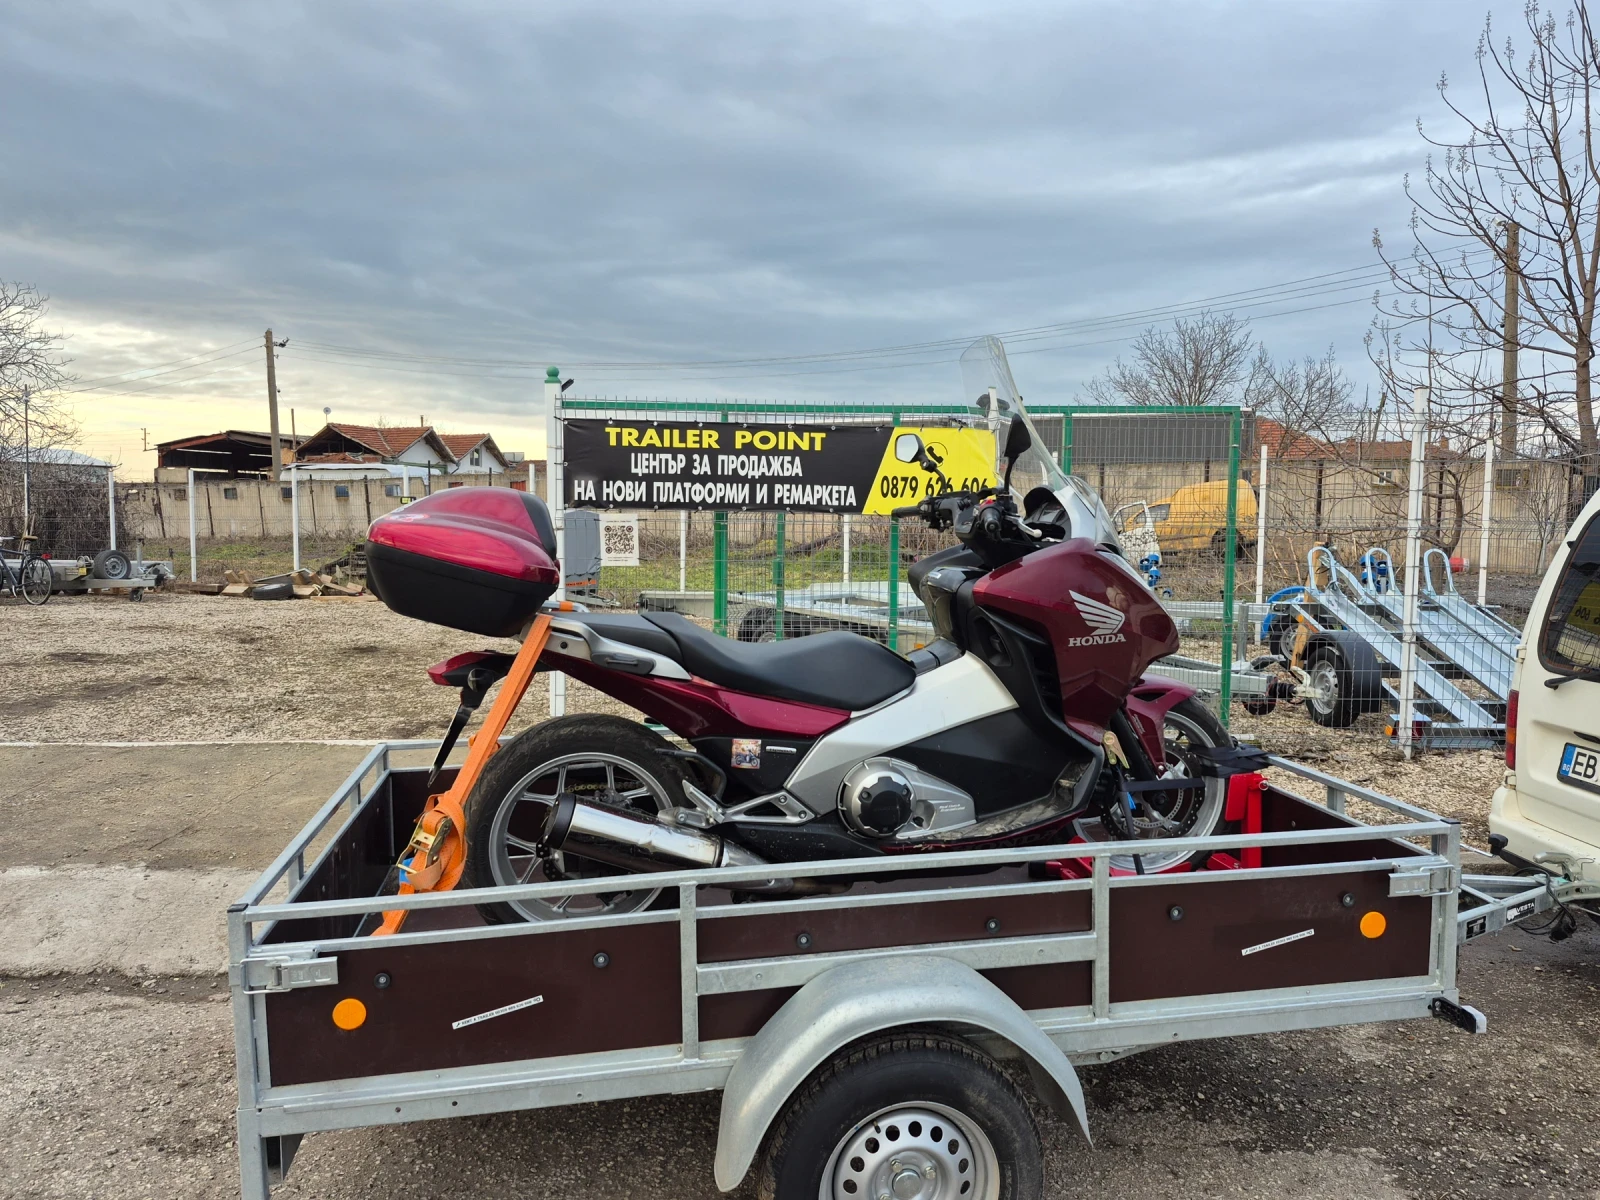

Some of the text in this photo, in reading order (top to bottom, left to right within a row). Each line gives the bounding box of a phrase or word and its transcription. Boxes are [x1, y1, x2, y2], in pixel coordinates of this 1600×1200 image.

[605, 427, 827, 451] TRAILER POINT
[631, 453, 803, 479] ЦЕНТЪР ЗА ПРОДАЖБА
[574, 480, 857, 506] НА НОВИ ПЛАТФОРМИ И РЕМАРКЕТА
[880, 475, 919, 498] 0879
[1068, 633, 1127, 647] HONDA
[1571, 751, 1598, 779] EB
[1516, 902, 1535, 912] VESTA
